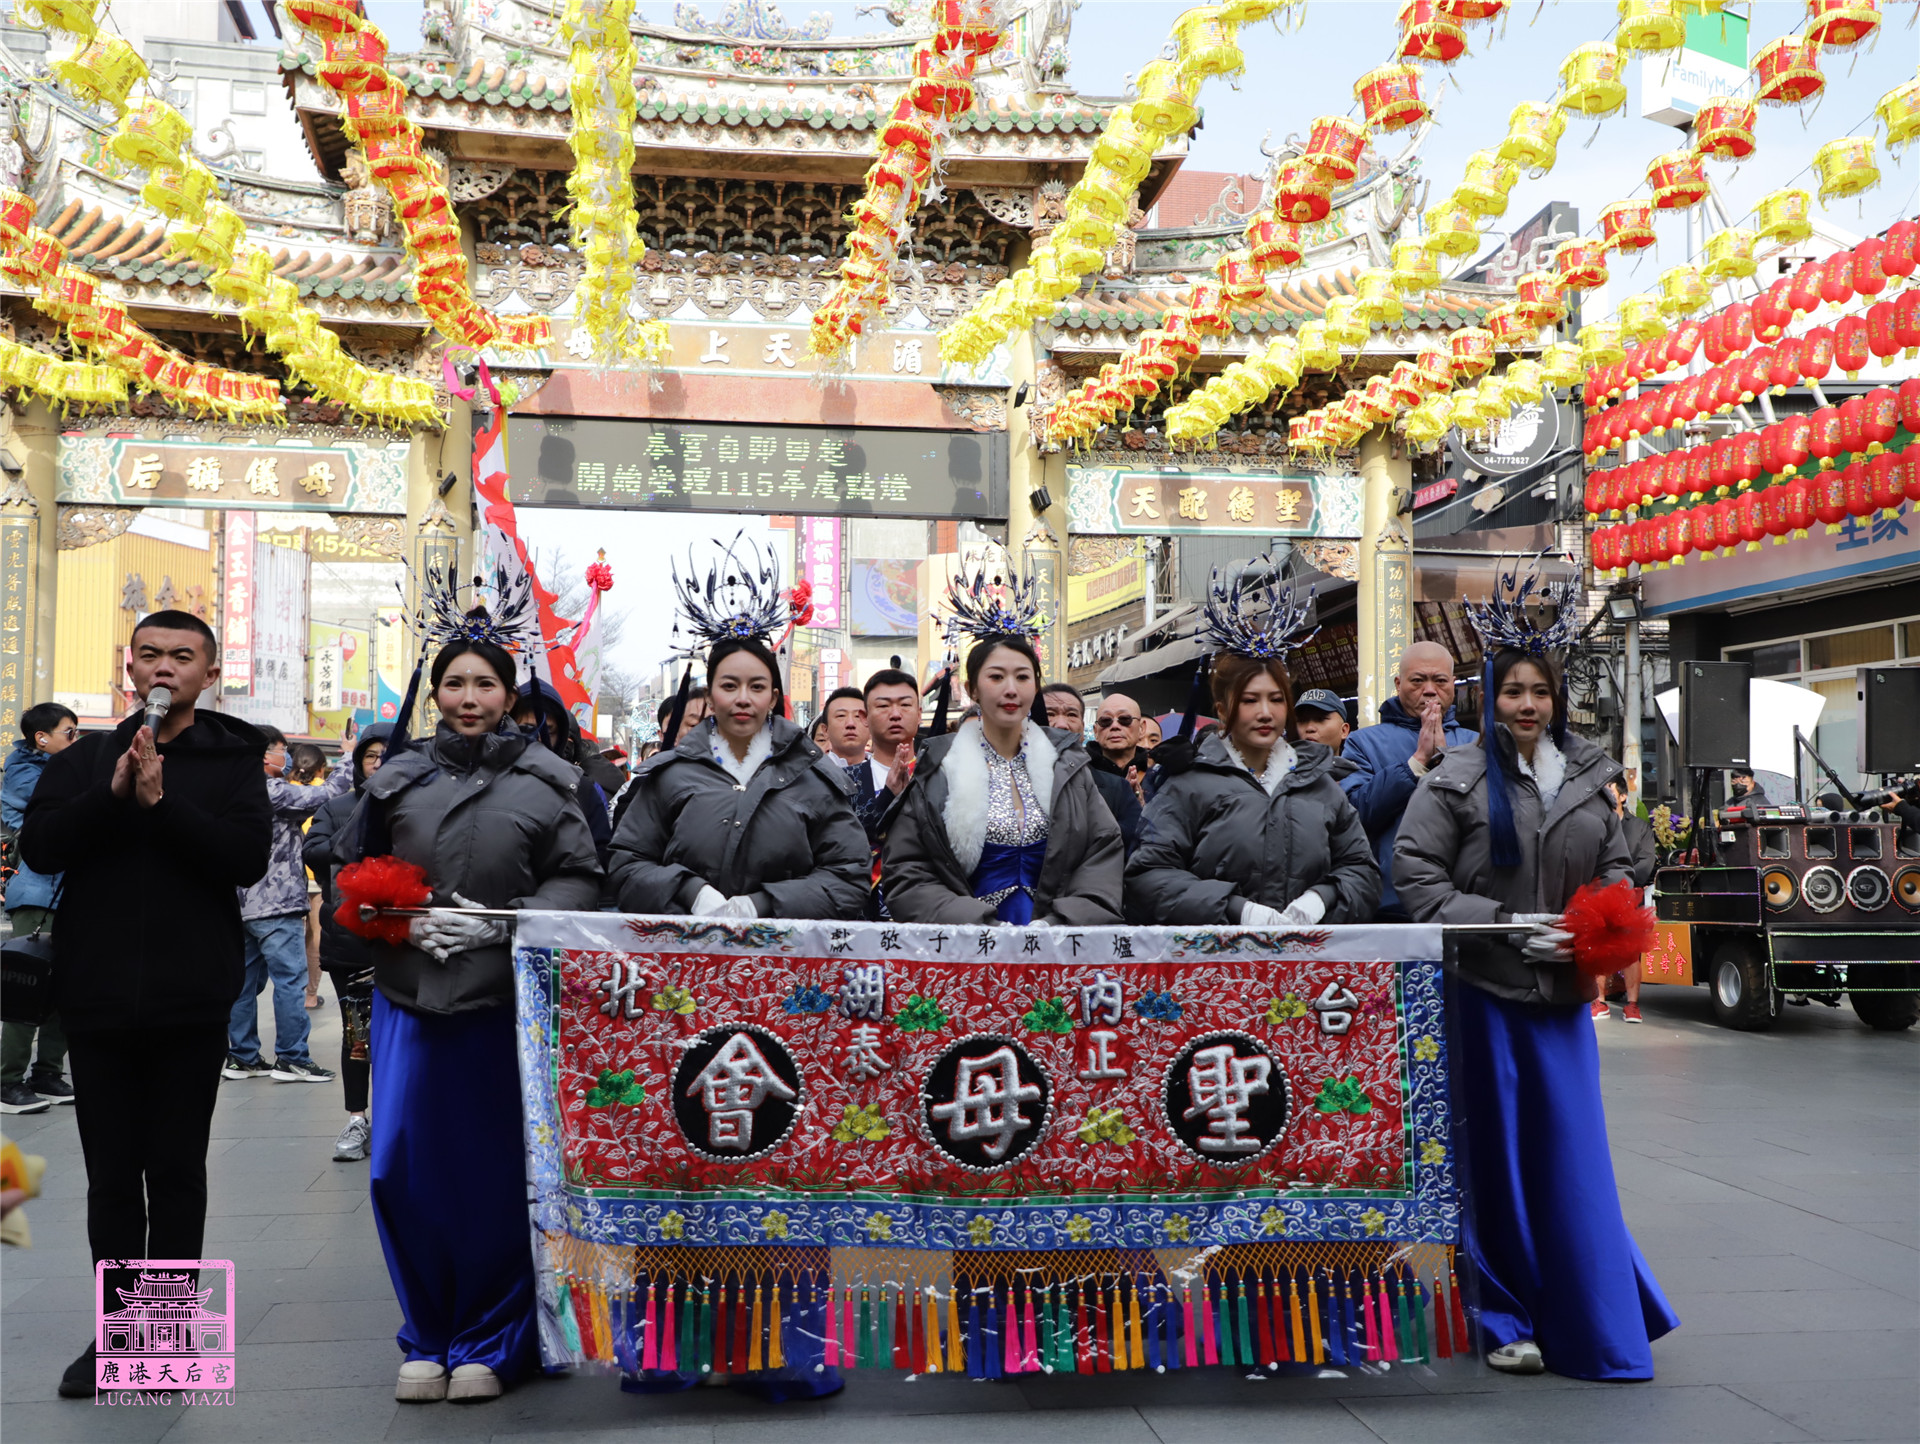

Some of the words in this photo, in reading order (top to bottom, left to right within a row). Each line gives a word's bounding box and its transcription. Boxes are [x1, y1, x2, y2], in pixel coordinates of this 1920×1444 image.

[1673, 60, 1745, 98] FamilyMart
[564, 328, 924, 375] 湄天上母
[126, 453, 336, 498] 母儀稱后
[1484, 456, 1530, 465] 04-7772627
[1129, 486, 1304, 523] 聖德配天
[600, 961, 647, 1020] 北
[838, 965, 886, 1021] 湖
[1080, 971, 1123, 1026] 內
[1314, 981, 1359, 1035] 台
[844, 1023, 891, 1080] 泰
[1079, 1030, 1128, 1080] 正
